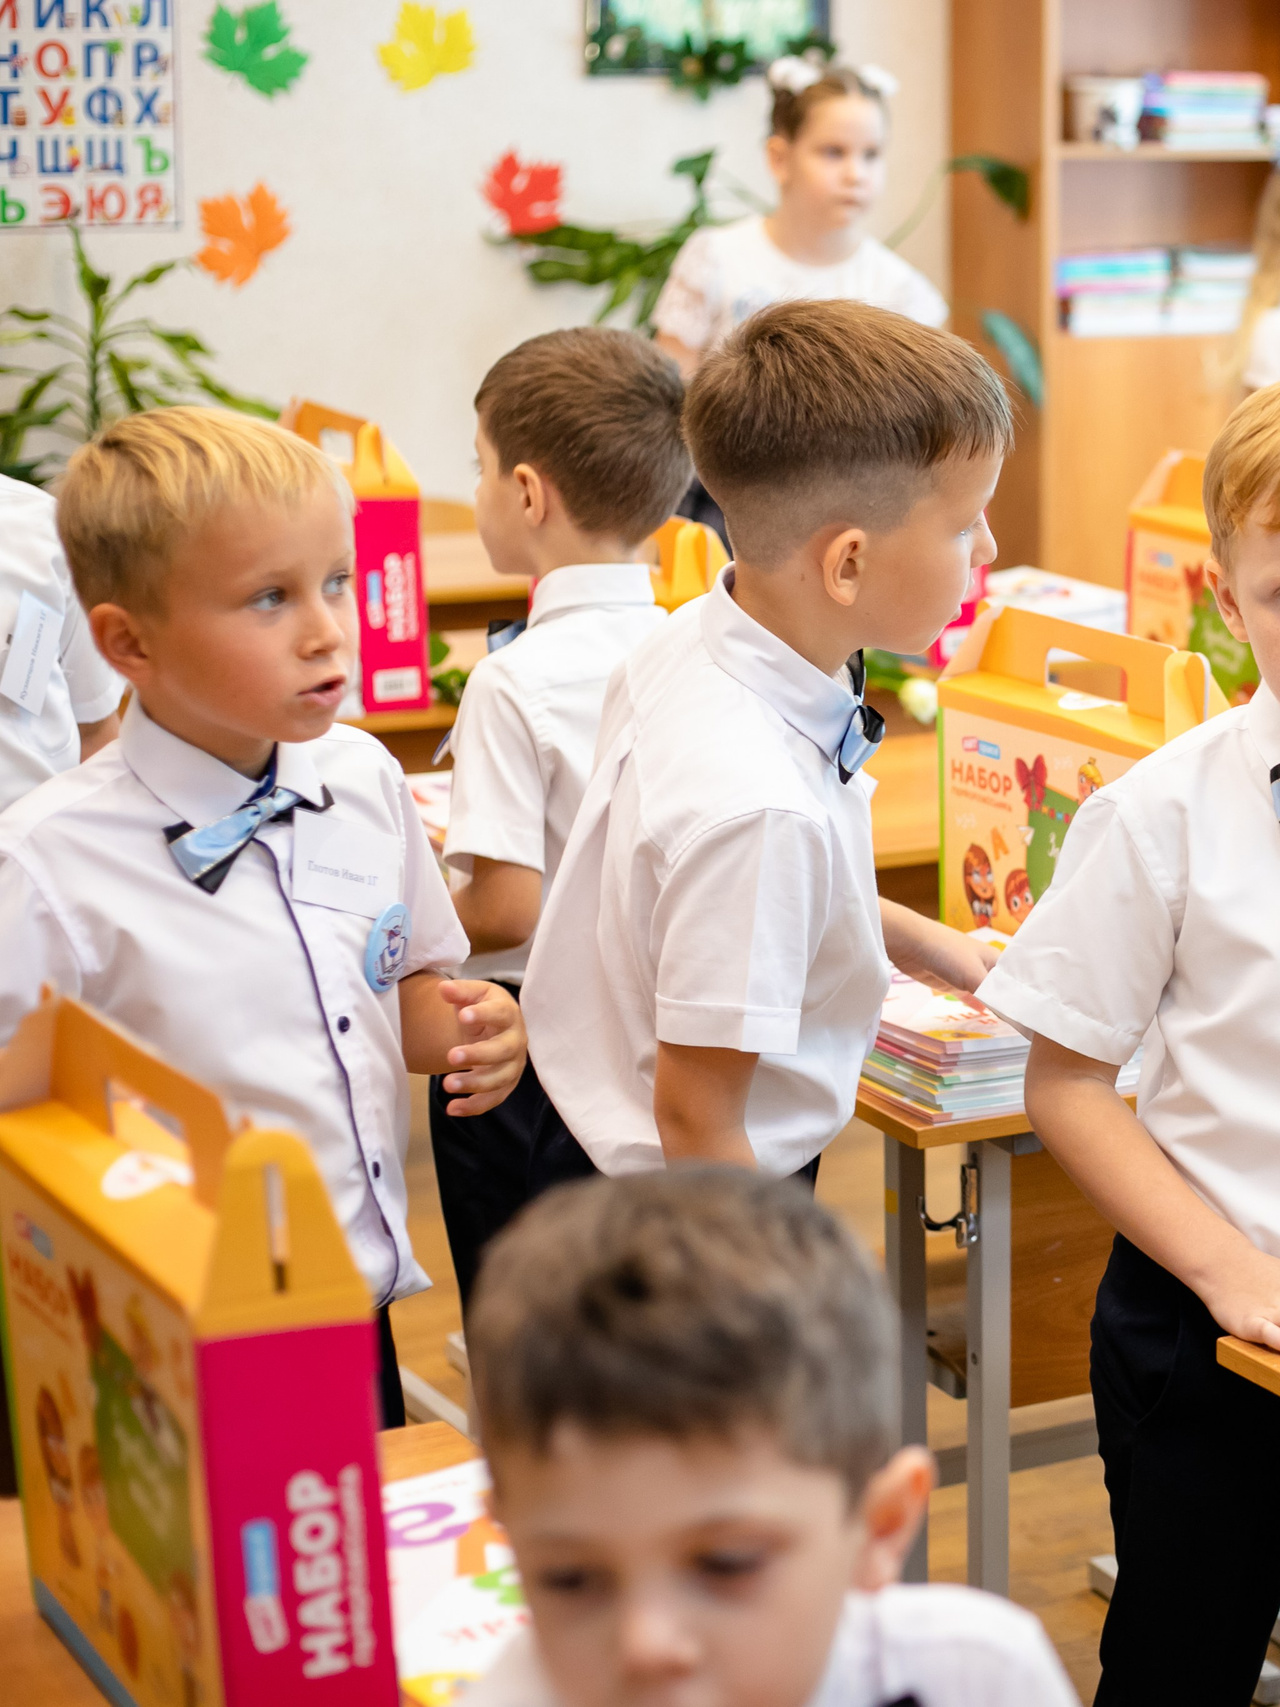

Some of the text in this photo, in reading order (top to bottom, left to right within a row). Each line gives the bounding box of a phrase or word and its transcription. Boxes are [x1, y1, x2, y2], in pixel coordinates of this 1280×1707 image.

[133, 42, 160, 78] Р
[37, 88, 70, 126] У
[85, 86, 124, 125] Ф
[134, 88, 161, 125] Х
[135, 137, 170, 175] Ъ
[40, 184, 73, 224] Э
[87, 183, 127, 224] Ю
[137, 183, 164, 222] Я
[951, 759, 1013, 797] НАБОР
[284, 1468, 352, 1680] НАБОР
